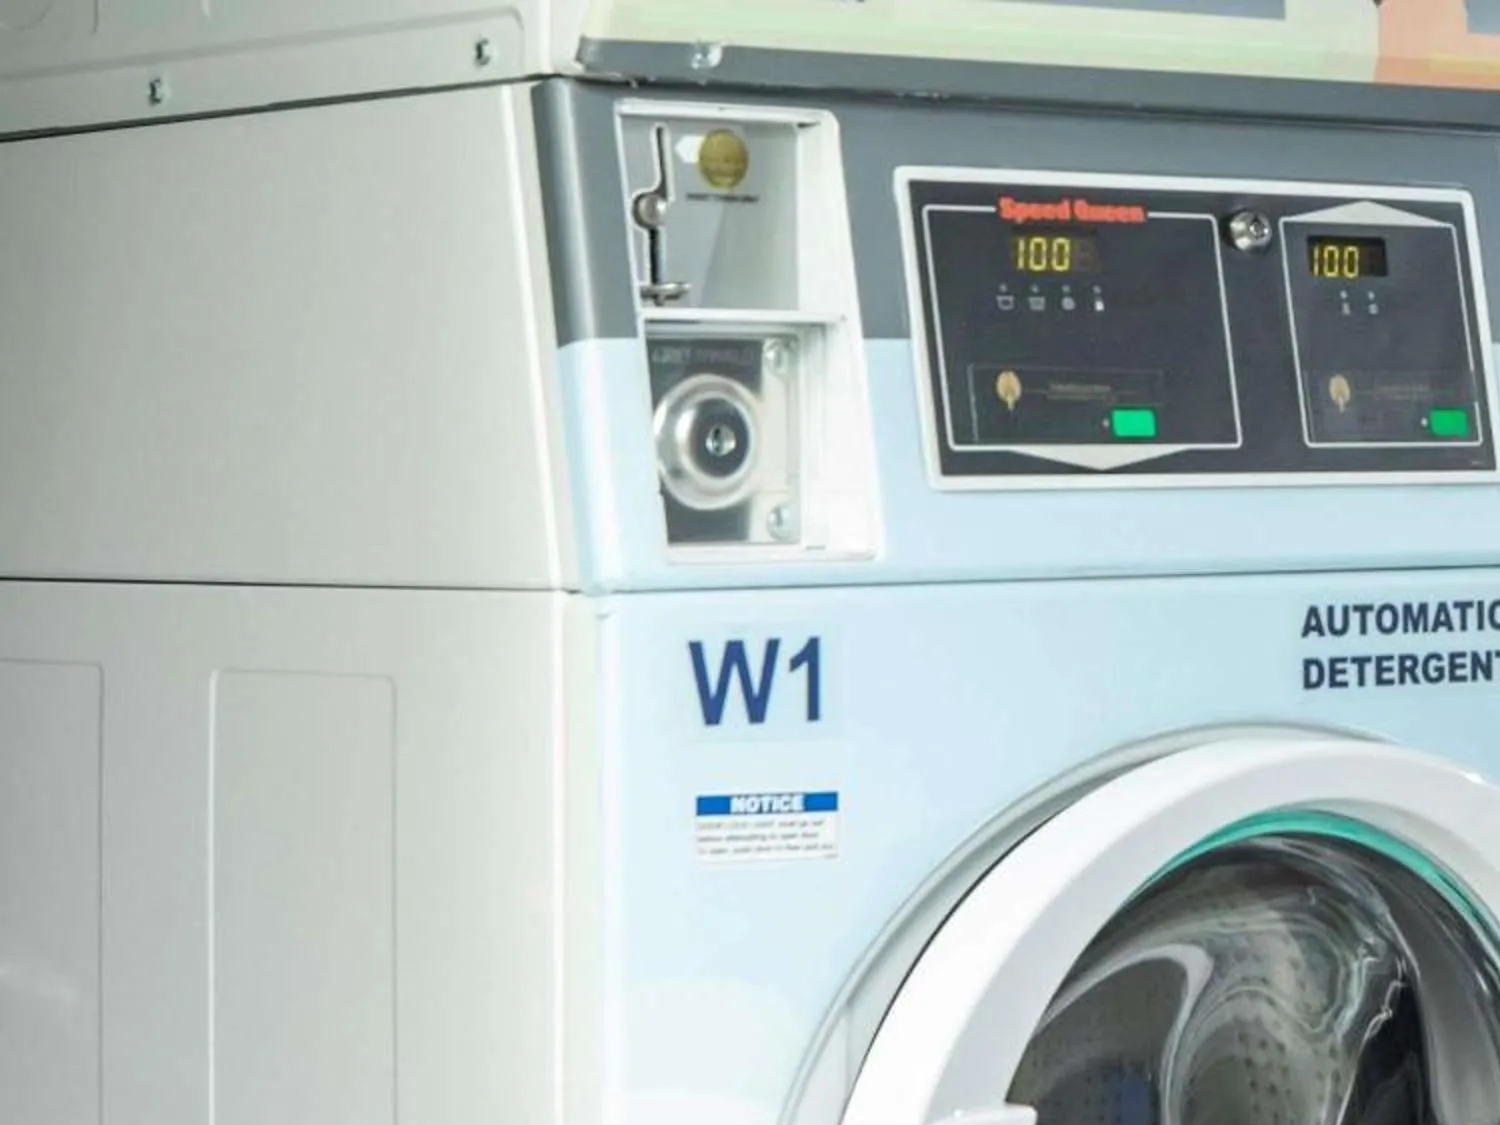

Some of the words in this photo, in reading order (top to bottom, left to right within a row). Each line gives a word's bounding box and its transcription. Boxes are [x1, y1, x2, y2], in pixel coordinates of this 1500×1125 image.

[1016, 236, 1071, 272] 100
[1313, 245, 1360, 279] 100
[687, 636, 821, 726] W1
[731, 794, 803, 814] NOTICE
